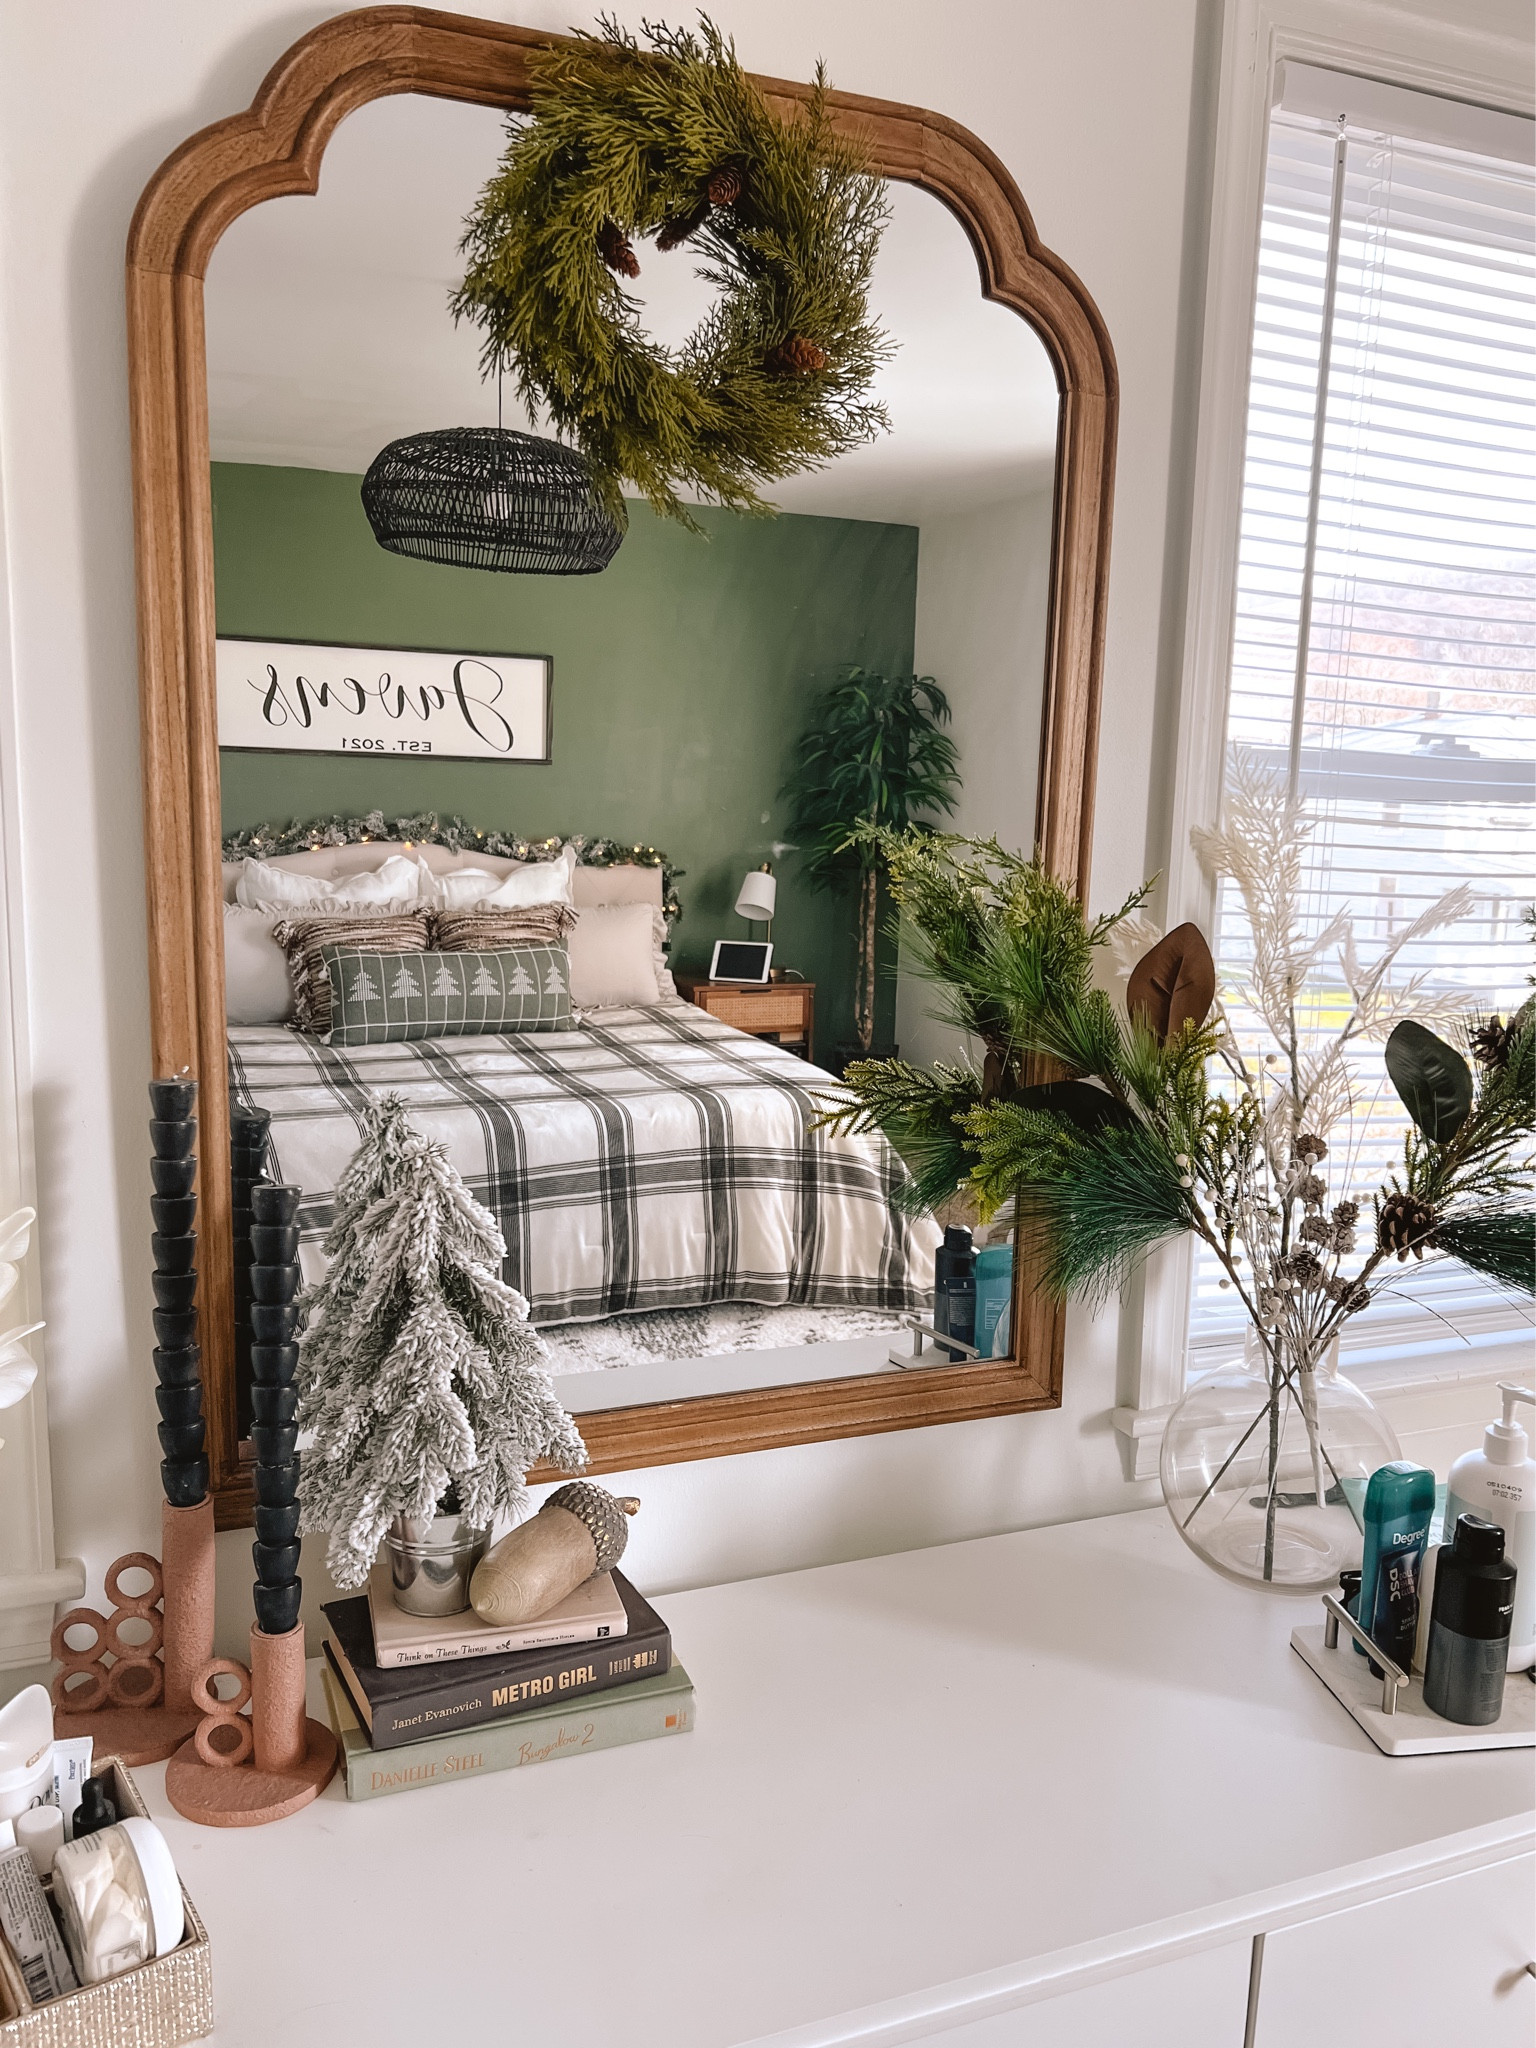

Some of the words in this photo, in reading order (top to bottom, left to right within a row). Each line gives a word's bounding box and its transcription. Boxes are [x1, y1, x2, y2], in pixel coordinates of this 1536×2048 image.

[1393, 1529, 1425, 1545] Degree
[1389, 1567, 1401, 1602] DSC
[396, 1652, 422, 1662] Think
[436, 1648, 459, 1658] These
[461, 1645, 488, 1655] Things
[391, 1713, 423, 1731] Janet
[425, 1698, 483, 1722] Evanovich
[492, 1676, 554, 1707] METRO
[558, 1665, 597, 1690] GIRL
[371, 1762, 439, 1790] DANIELLE
[443, 1753, 484, 1774] STEEL
[518, 1727, 579, 1765] Bungalow
[582, 1723, 595, 1746] 2
